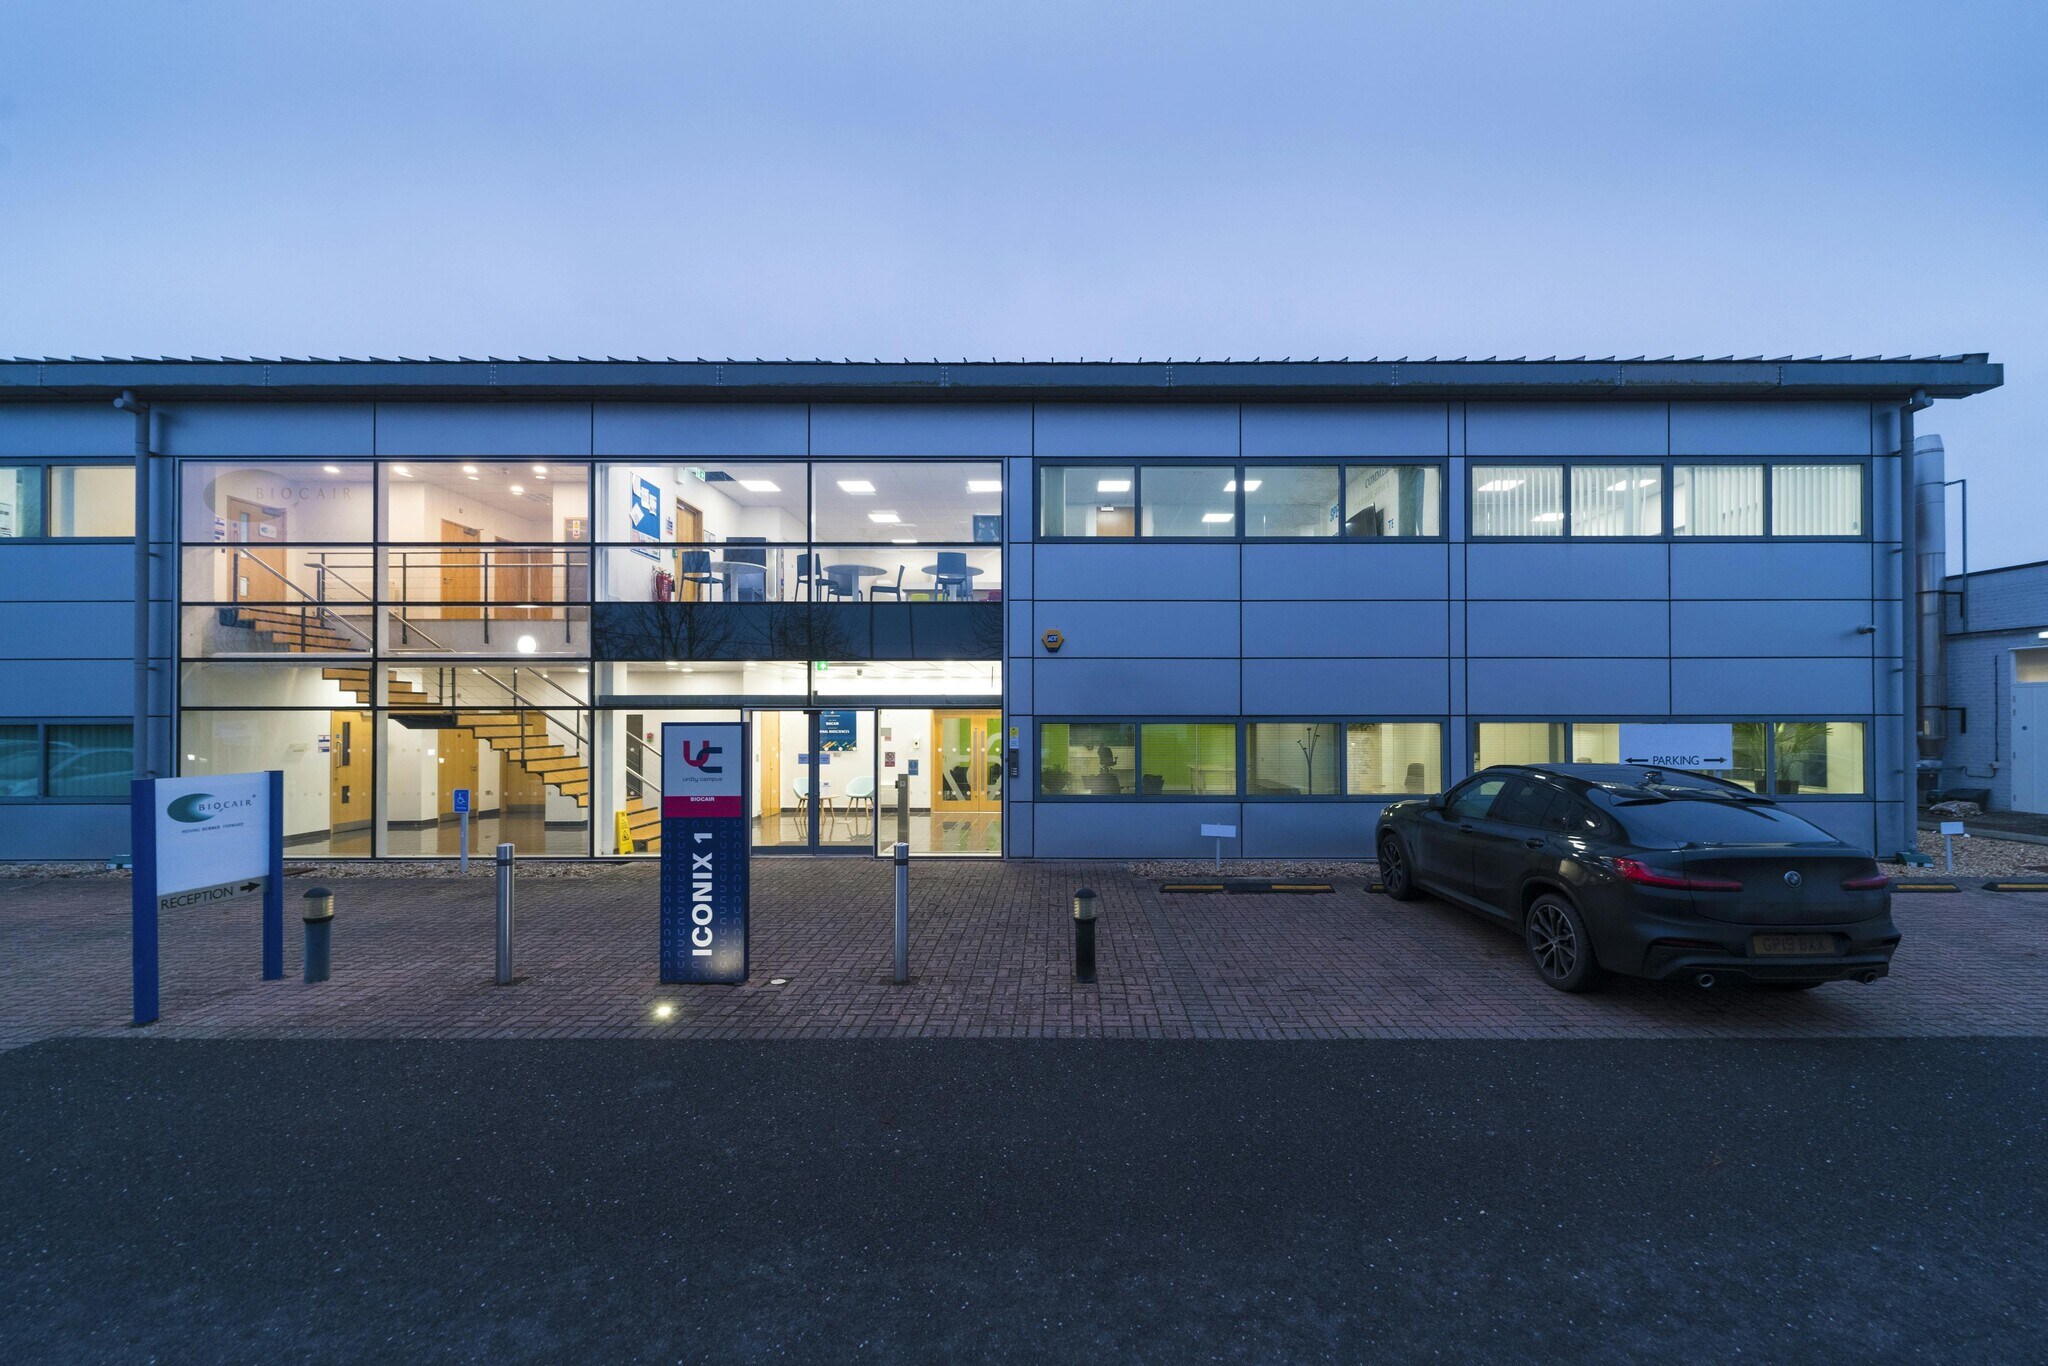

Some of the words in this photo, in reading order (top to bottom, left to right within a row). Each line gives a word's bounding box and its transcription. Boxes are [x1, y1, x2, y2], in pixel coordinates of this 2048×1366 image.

[256, 487, 352, 500] BIOCAIR
[1652, 755, 1700, 766] PARKING
[198, 799, 252, 812] BIOCAIR
[693, 832, 713, 844] 1
[160, 886, 234, 910] RECEPTION
[691, 852, 713, 956] ICONIX
